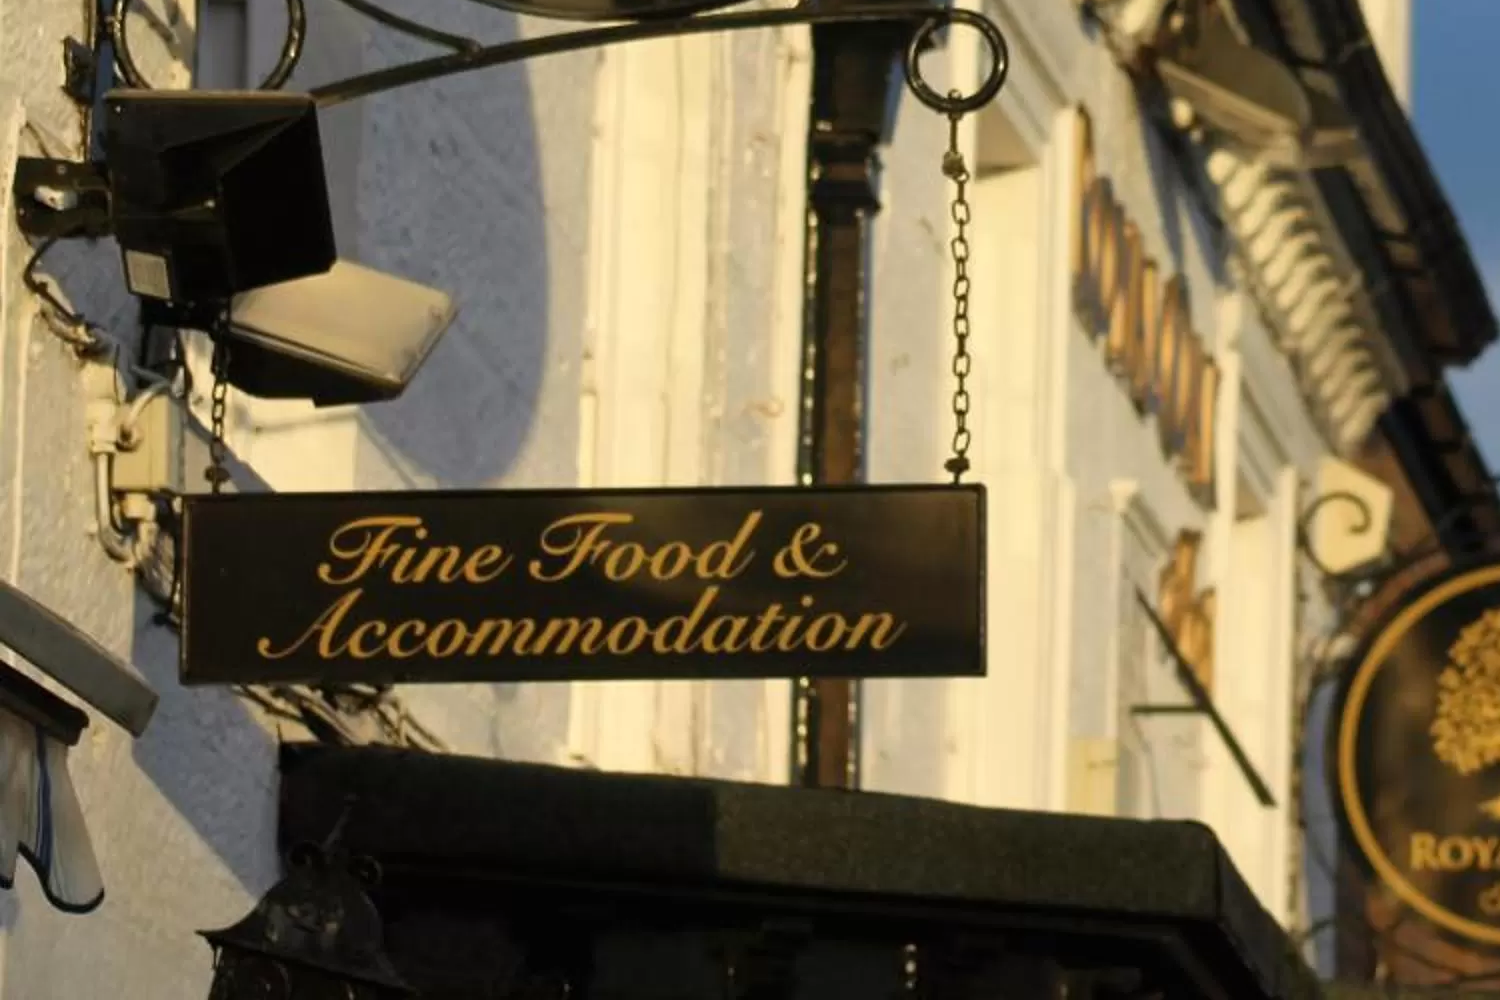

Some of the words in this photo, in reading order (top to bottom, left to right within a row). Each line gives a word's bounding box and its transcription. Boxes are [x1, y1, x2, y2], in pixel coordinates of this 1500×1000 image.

[317, 514, 512, 585] Fine
[529, 510, 763, 582] Food
[772, 521, 848, 578] &
[257, 585, 907, 661] Accommodation
